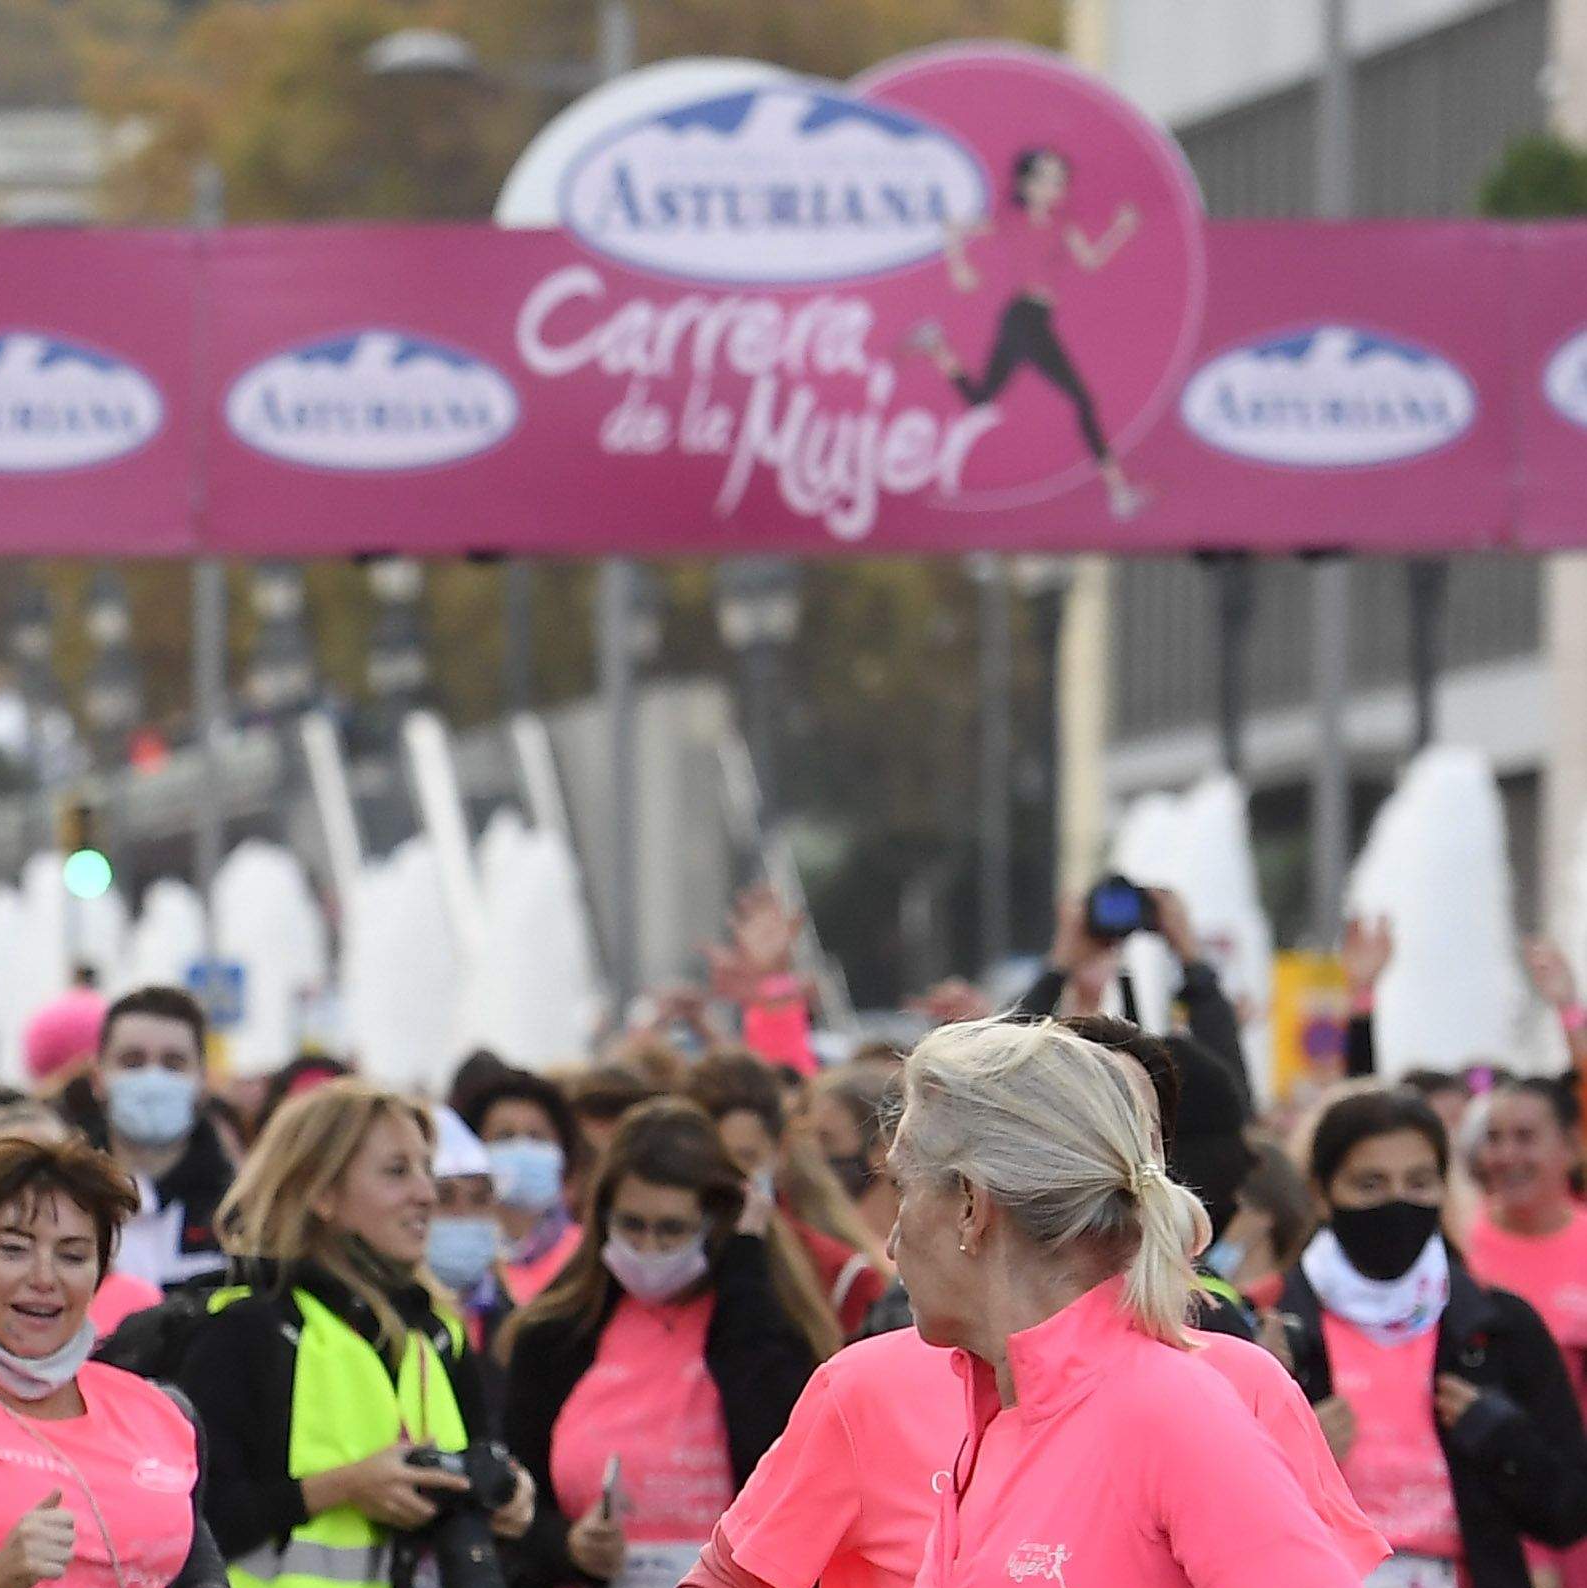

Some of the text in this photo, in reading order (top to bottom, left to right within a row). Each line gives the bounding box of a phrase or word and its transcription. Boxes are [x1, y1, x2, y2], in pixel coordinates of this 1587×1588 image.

[597, 160, 953, 230] ASTURIANA
[515, 264, 875, 378] Carrera
[253, 387, 490, 431] ASTURIANA
[599, 374, 734, 455] de la
[1209, 382, 1450, 427] ASTURIANA
[715, 362, 1002, 541] Mujer
